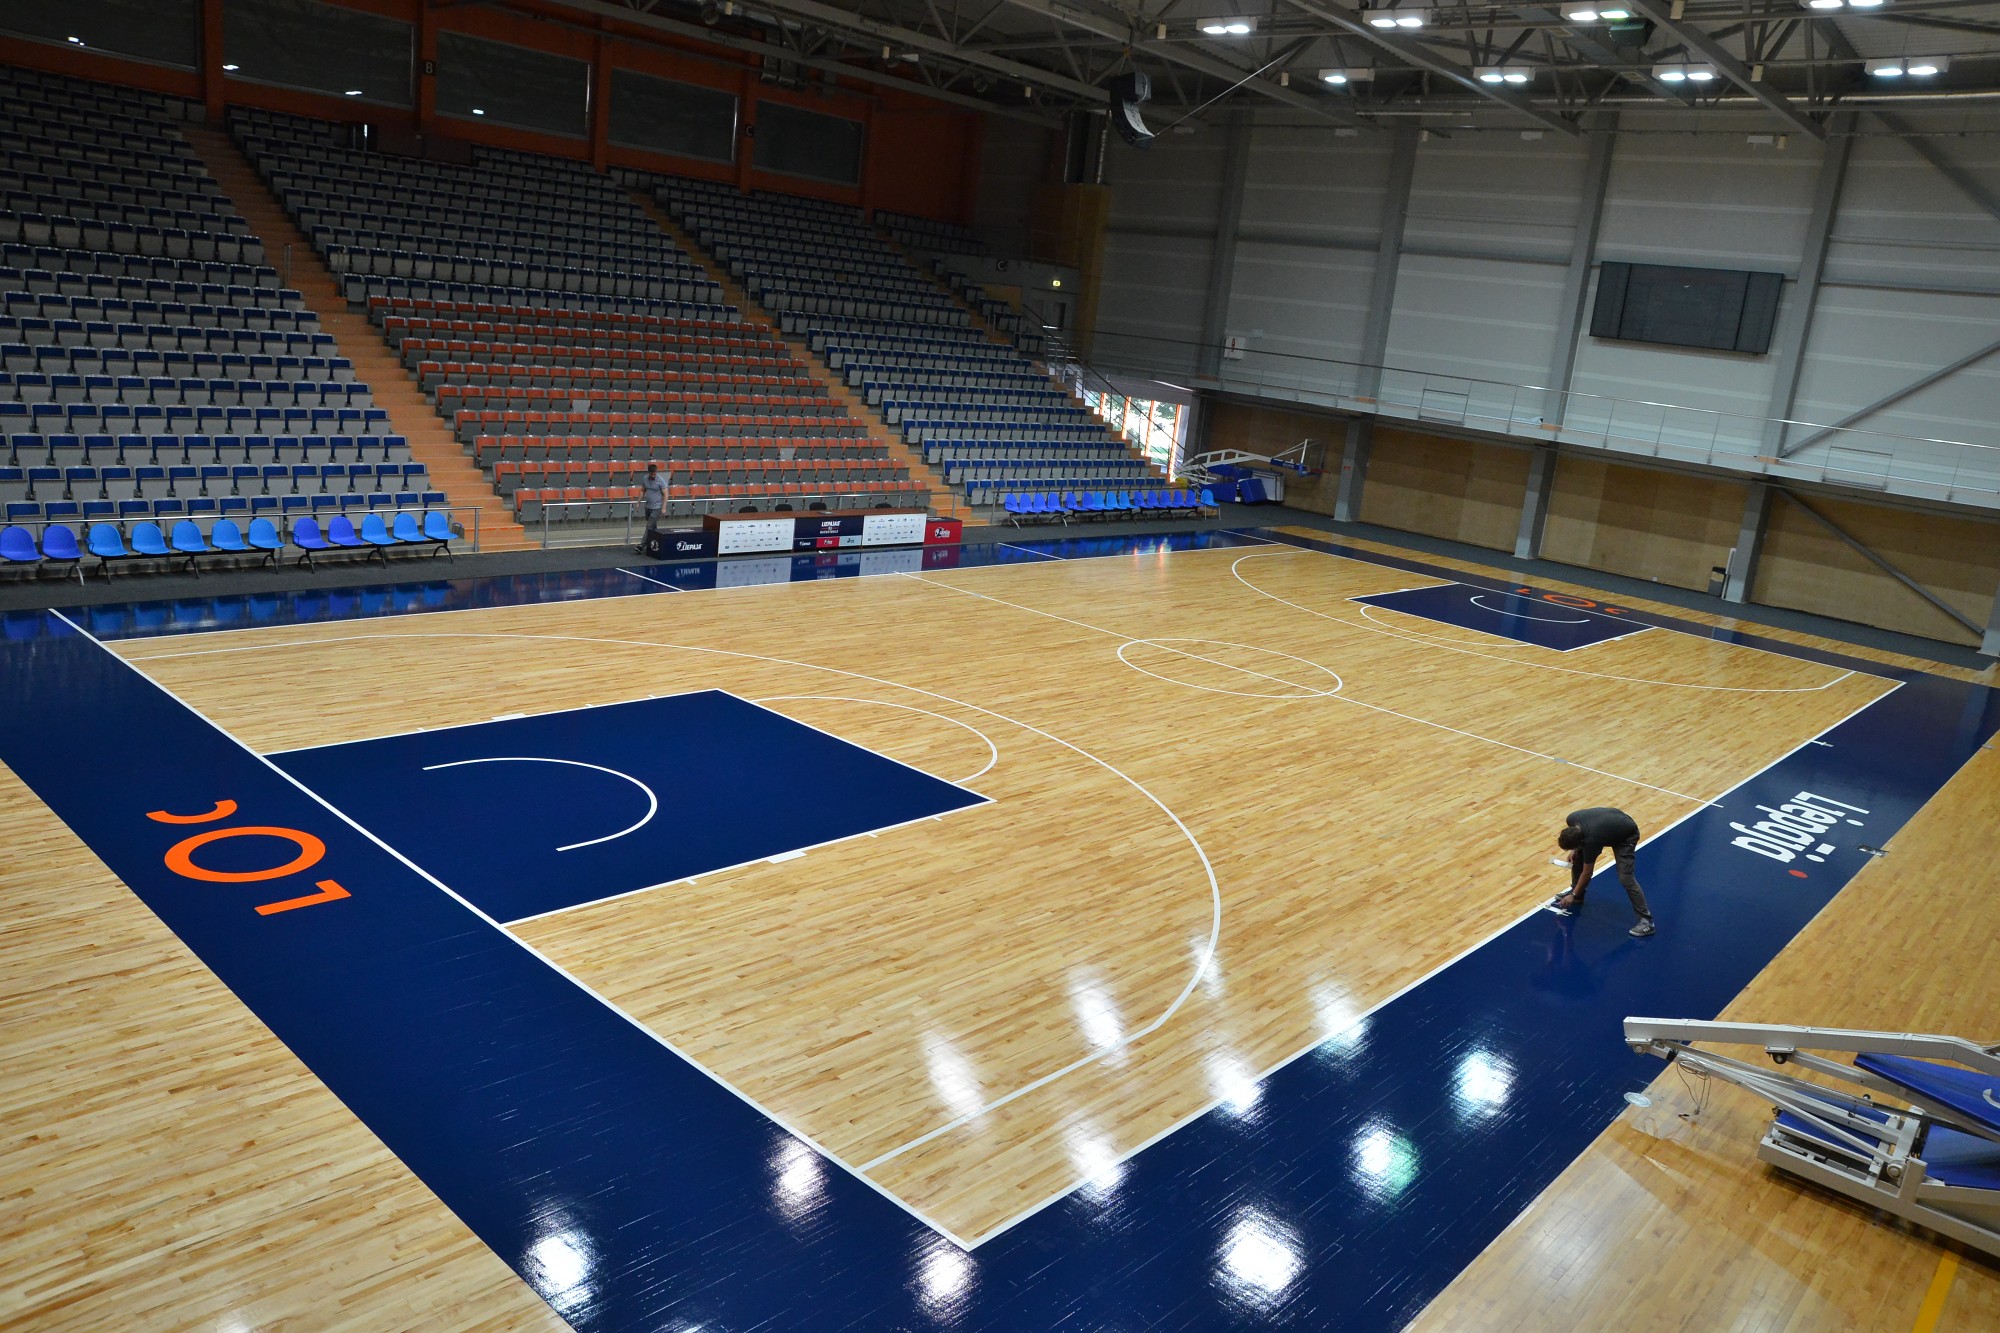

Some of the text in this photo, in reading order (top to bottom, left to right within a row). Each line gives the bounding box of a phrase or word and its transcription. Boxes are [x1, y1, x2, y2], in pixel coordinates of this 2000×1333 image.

[425, 61, 433, 74] B
[746, 125, 753, 137] C
[1729, 791, 1870, 863] Liepāja
